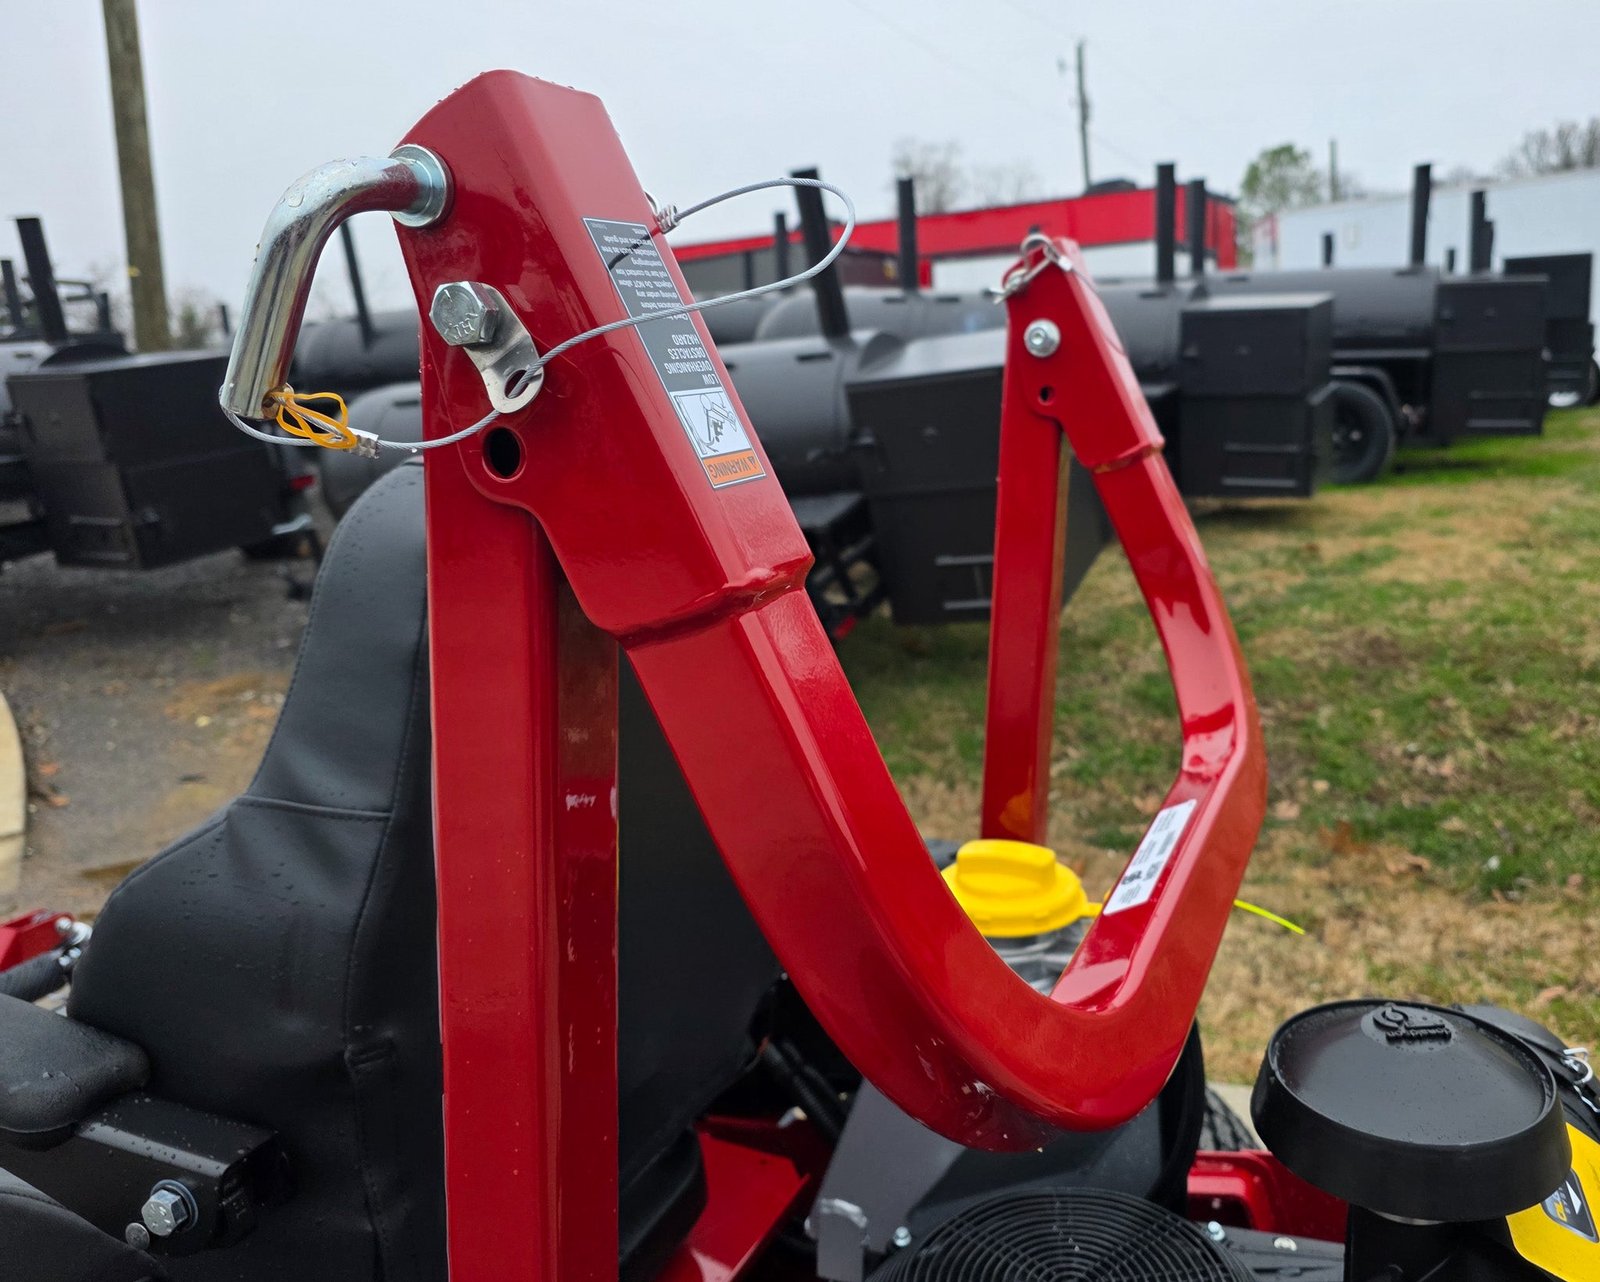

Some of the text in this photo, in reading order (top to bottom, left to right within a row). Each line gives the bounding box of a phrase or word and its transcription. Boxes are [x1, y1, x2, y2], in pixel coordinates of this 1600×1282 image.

[633, 280, 645, 288] NOT
[672, 334, 700, 345] HAZARD
[667, 347, 706, 360] OBSTACLES
[664, 360, 712, 374] OVERHANGING
[702, 374, 719, 384] LOW
[708, 458, 751, 479] WARNING
